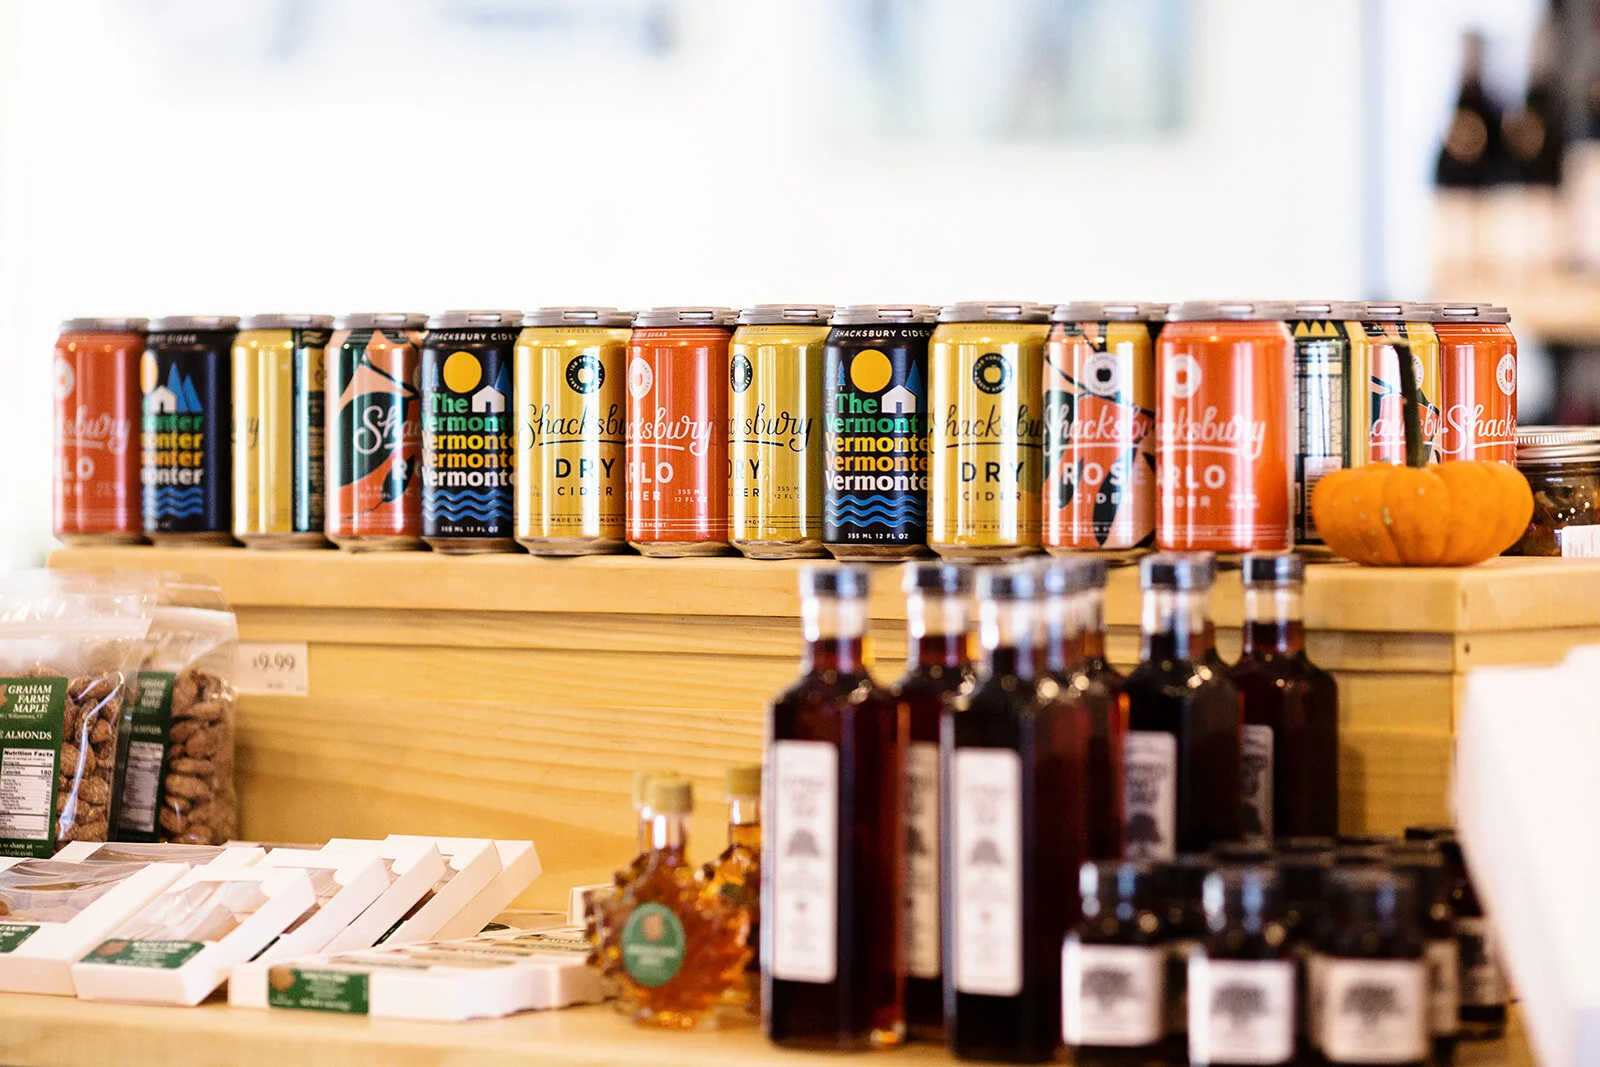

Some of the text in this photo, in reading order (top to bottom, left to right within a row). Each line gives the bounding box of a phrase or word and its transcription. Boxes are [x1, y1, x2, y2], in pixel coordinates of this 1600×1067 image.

[430, 332, 486, 341] SHACKSBURY
[834, 330, 897, 338] SHACKSBURY
[430, 392, 469, 413] The
[835, 392, 878, 414] The
[555, 458, 616, 479] DRY
[961, 461, 1024, 483] DRY
[8, 684, 53, 695] GRAHAM
[17, 694, 51, 704] FARMS
[13, 703, 48, 713] MAPLE
[5, 730, 52, 740] ALMONDS
[33, 750, 53, 758] Facts
[40, 769, 52, 777] 180
[9, 842, 26, 850] share
[26, 842, 33, 850] at
